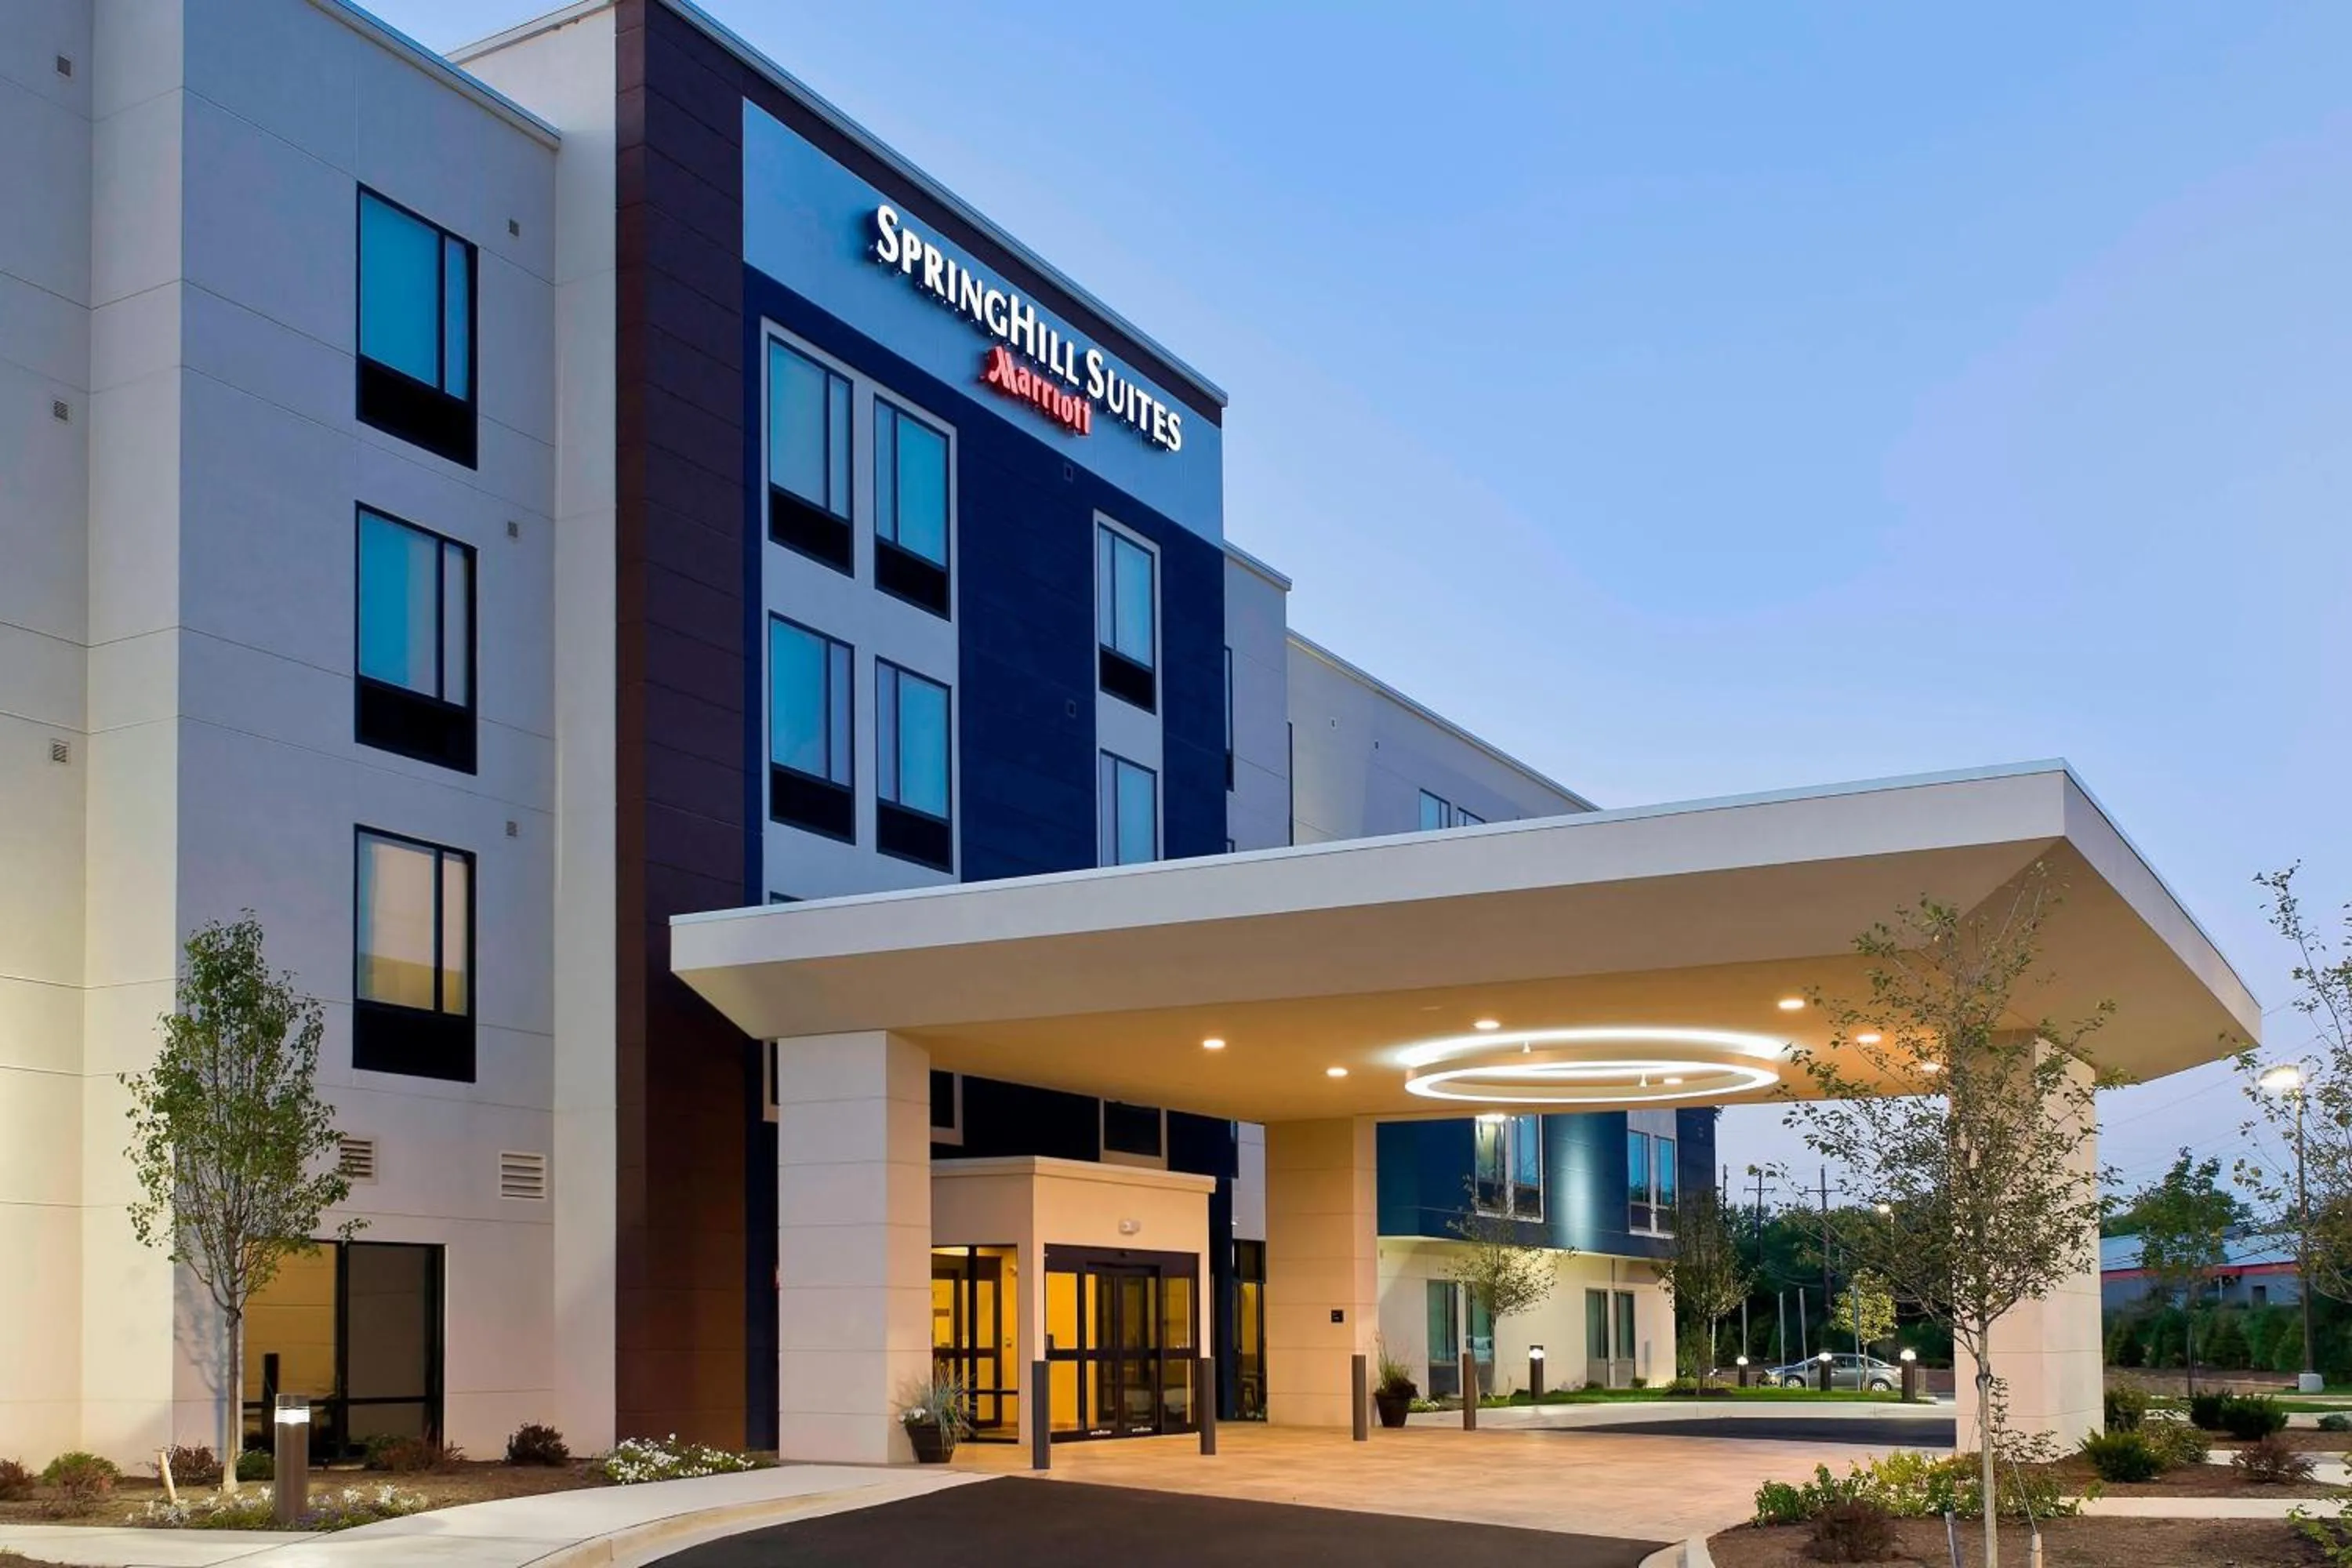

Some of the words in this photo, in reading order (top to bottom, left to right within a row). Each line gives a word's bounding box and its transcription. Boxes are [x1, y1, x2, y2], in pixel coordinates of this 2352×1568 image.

[876, 205, 1080, 387] SPRINGHILL
[1086, 348, 1182, 452] SUITES
[987, 345, 1092, 435] Marriott
